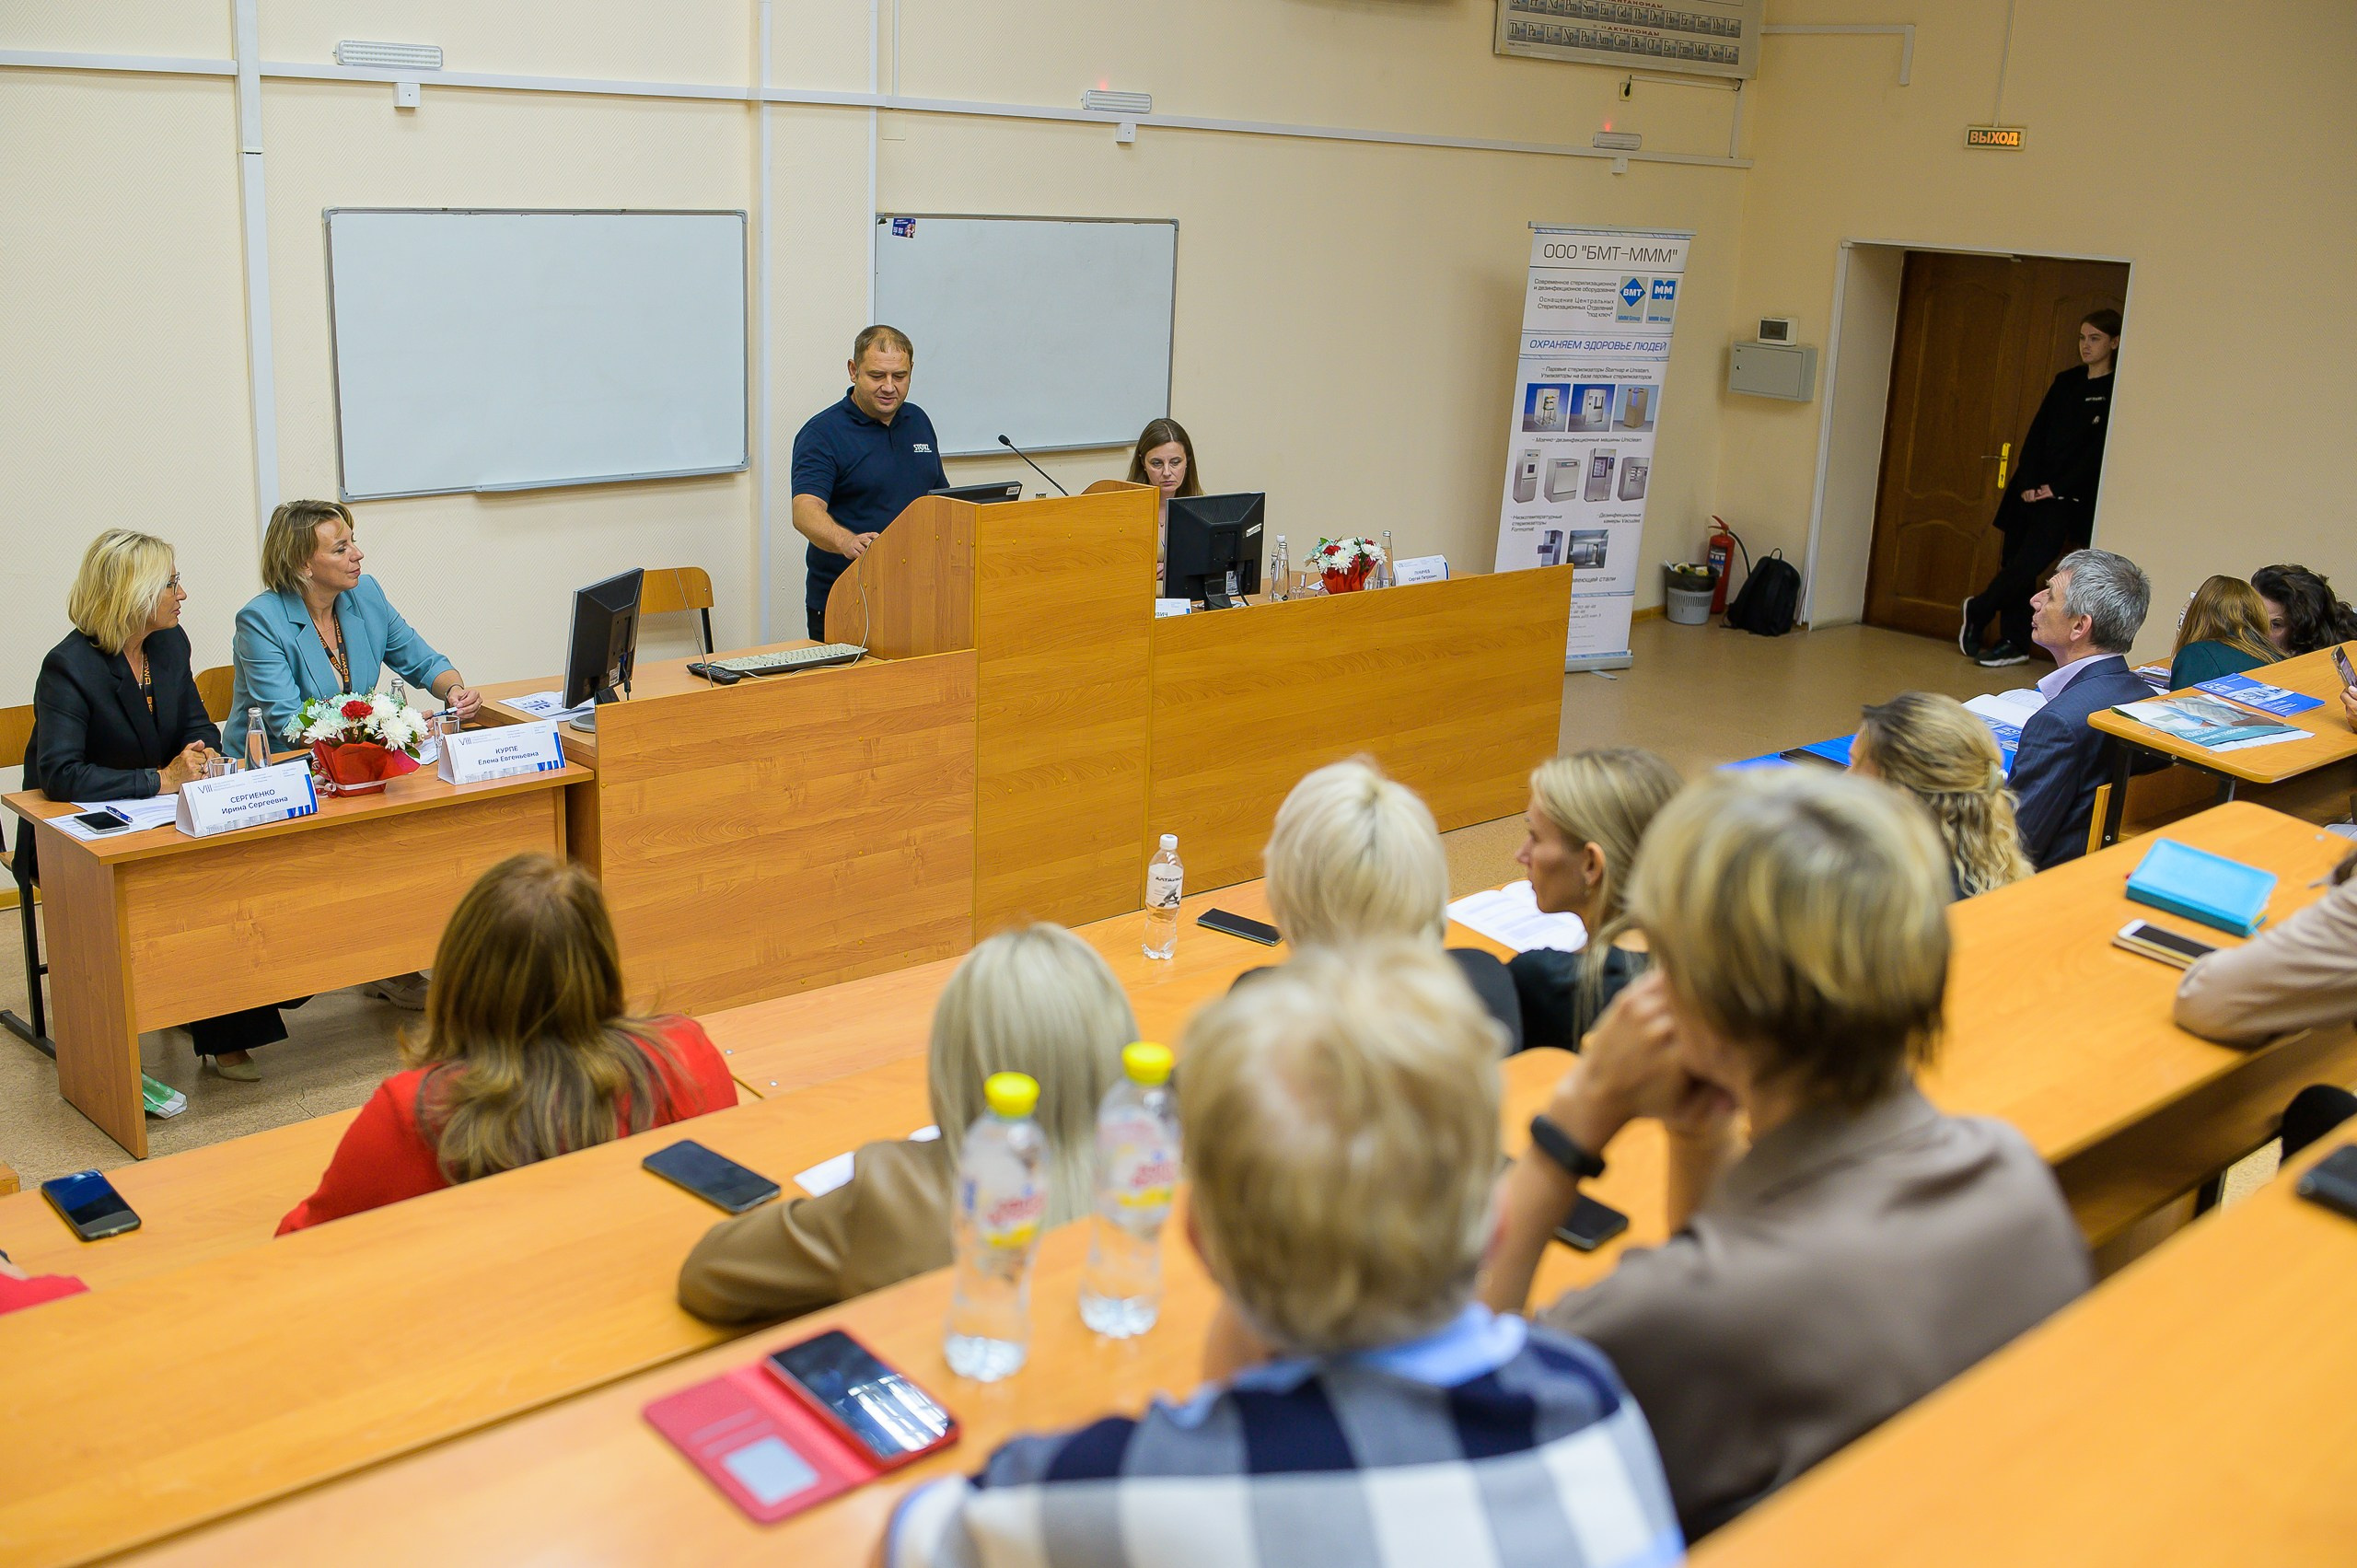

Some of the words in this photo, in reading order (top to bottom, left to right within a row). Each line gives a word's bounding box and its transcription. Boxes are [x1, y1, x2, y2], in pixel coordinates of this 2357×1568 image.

[1565, 1, 1576, 11] Pm
[1583, 2, 1594, 14] Sm
[1599, 3, 1609, 16] Eu
[1617, 6, 1627, 17] Gd
[1633, 8, 1643, 19] Tb
[1510, 21, 1519, 35] Th
[1527, 24, 1537, 37] Pa
[1546, 26, 1553, 38] U
[1563, 29, 1573, 42] Np
[1581, 30, 1590, 42] Pu
[1596, 33, 1608, 45] Am
[1614, 34, 1626, 47] Cm
[1664, 40, 1671, 52] Es
[1678, 41, 1689, 54] Fm
[1694, 43, 1704, 55] Md
[1710, 45, 1719, 57] No
[1969, 131, 2018, 146] ВЫХОД
[1543, 243, 1578, 260] ООО
[1538, 296, 1573, 304] Оснащение
[1529, 339, 1582, 350] ОХРАНЯЕМ
[1583, 341, 1632, 351] ЗДОРОВЬЕ
[1632, 342, 1667, 352] ЛЮДЕЙ
[458, 738, 472, 747] VIII
[495, 745, 518, 754] КУРПЕ
[478, 757, 499, 766] Елена
[500, 750, 540, 762] Евгеньевна
[197, 784, 214, 794] VIII
[230, 788, 275, 804] СЕРГИЕНКО
[221, 804, 247, 815] Ирина
[248, 796, 288, 809] Сергеевна
